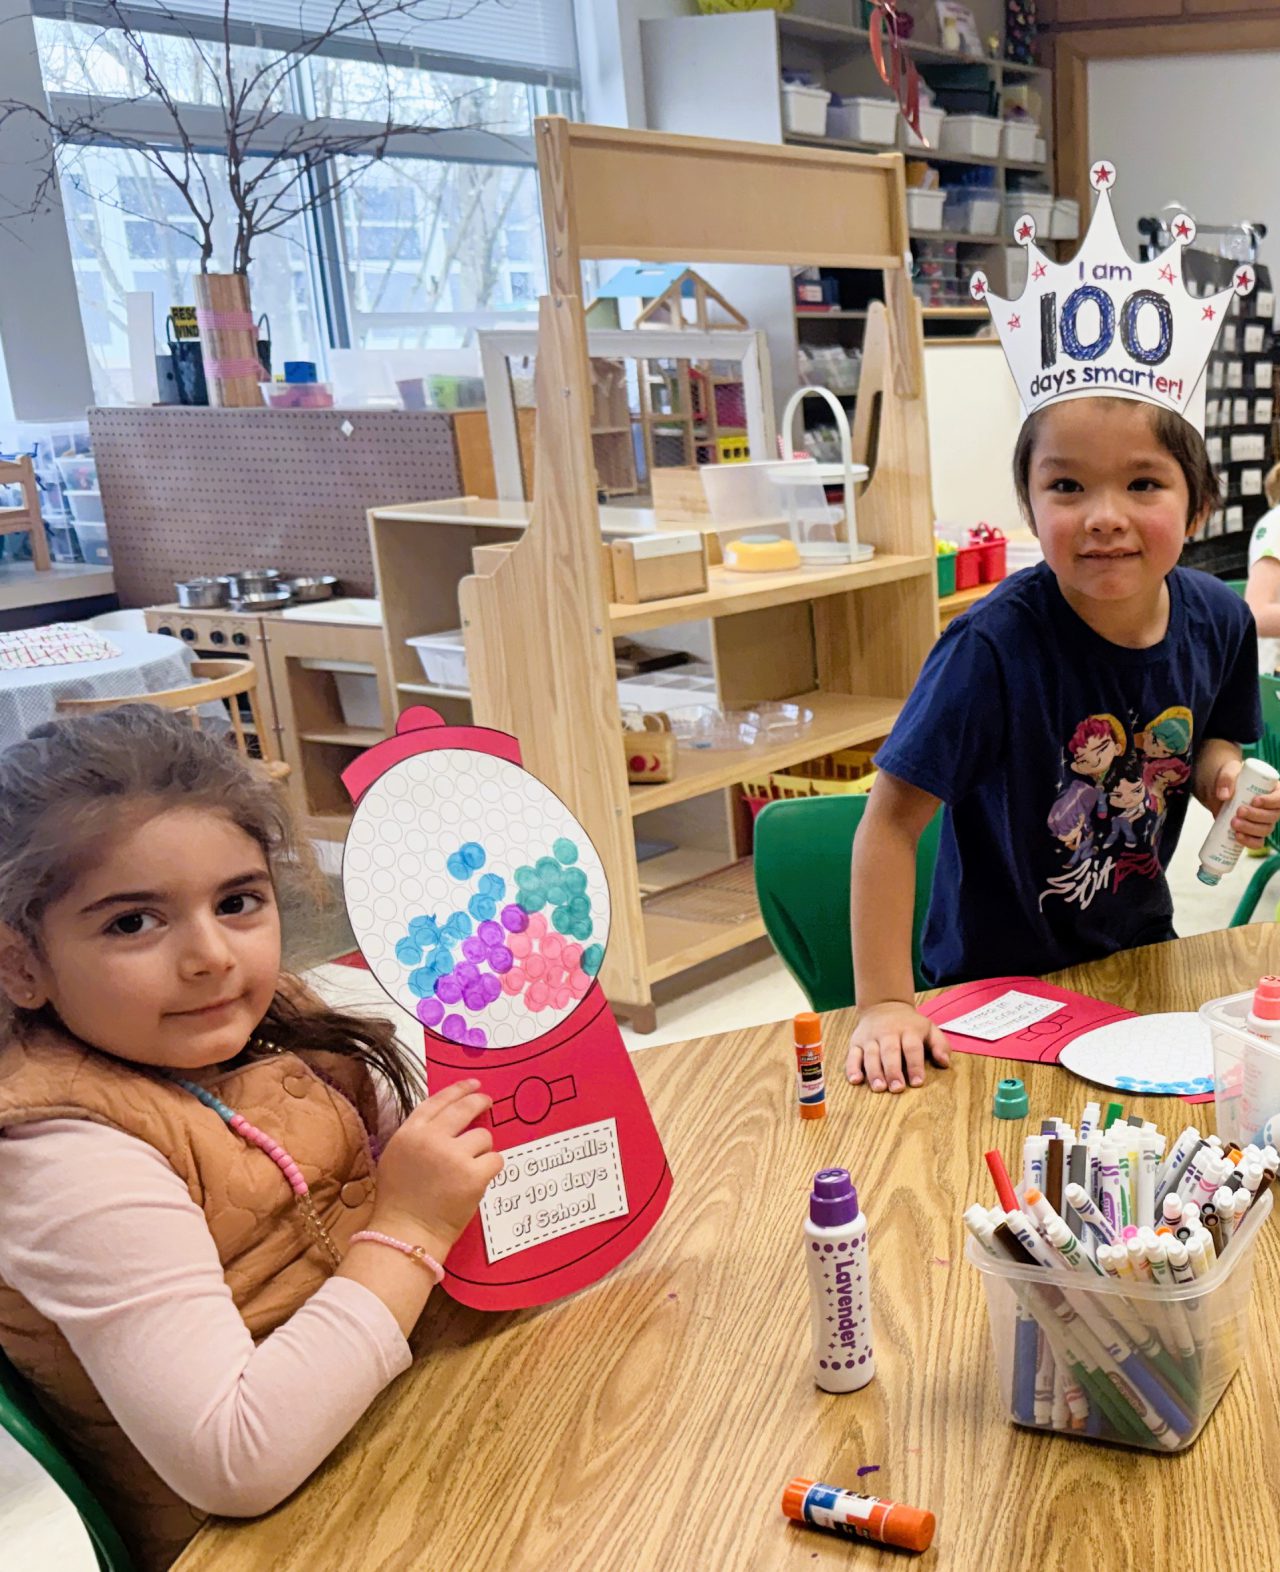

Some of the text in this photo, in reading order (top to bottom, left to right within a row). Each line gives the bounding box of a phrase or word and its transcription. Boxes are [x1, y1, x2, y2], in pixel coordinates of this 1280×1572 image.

[1079, 261, 1132, 281] I am
[1040, 282, 1173, 370] 100
[1030, 366, 1183, 400] days smarter!
[524, 1138, 608, 1176] Gumballs
[494, 1167, 609, 1216] for 100 days
[512, 1193, 597, 1237] of School
[835, 1259, 858, 1350] Lavender
